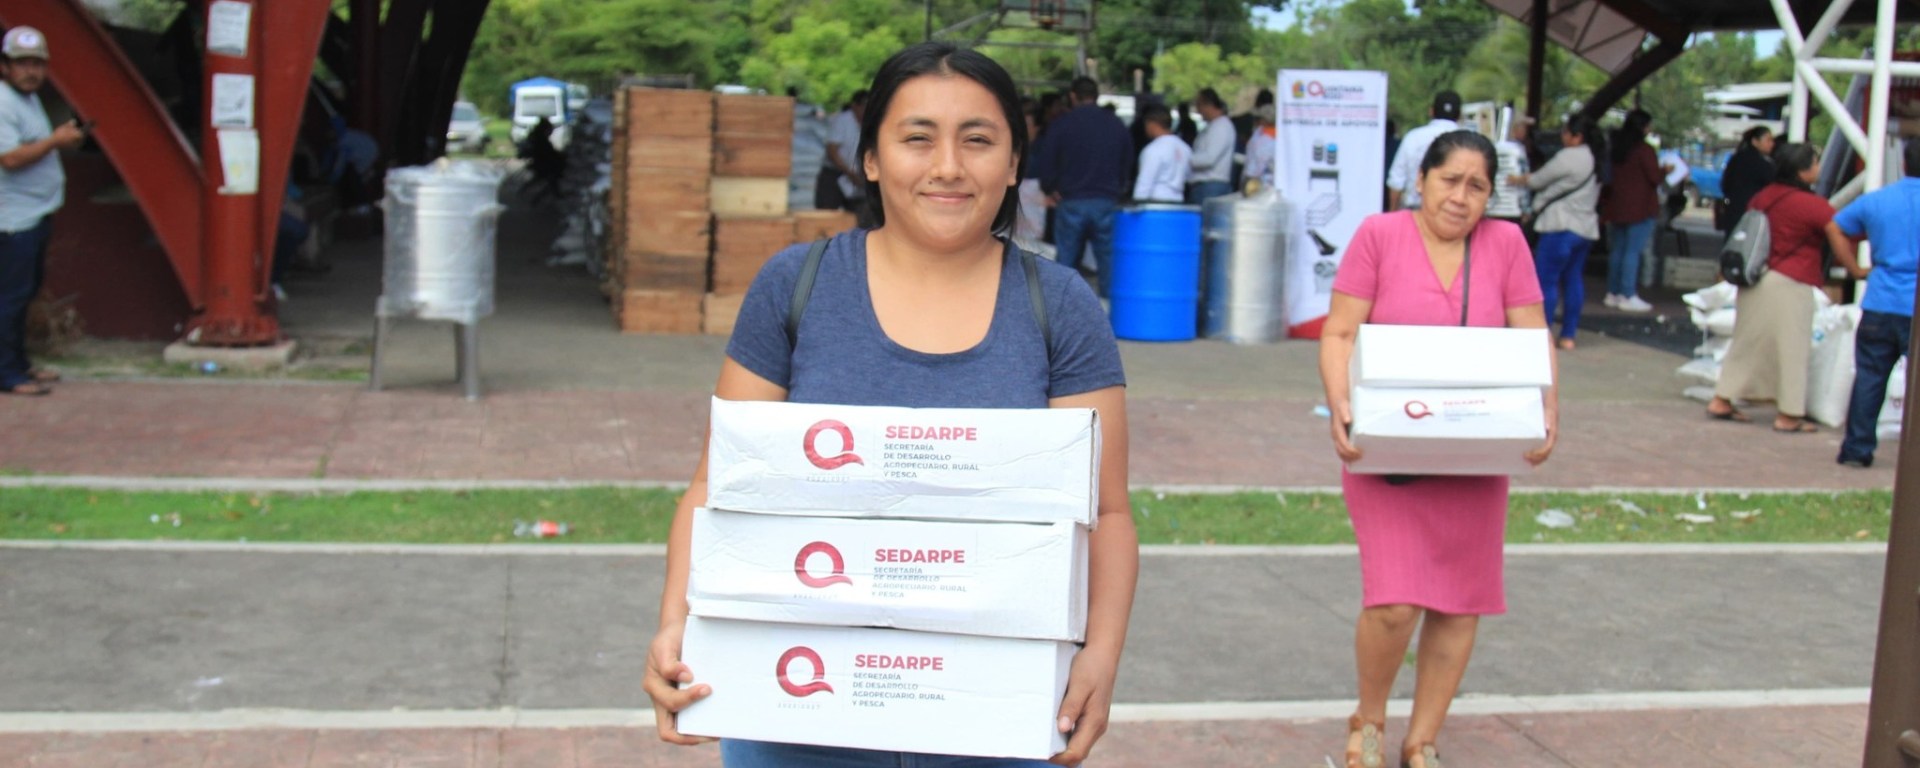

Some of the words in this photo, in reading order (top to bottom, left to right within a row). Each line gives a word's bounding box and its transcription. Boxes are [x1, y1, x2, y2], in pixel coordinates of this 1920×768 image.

[1326, 119, 1338, 127] DE
[885, 425, 977, 441] SEDARPE
[884, 443, 934, 451] SECRETARÍA
[897, 453, 951, 461] DESARROLLO
[874, 548, 965, 564] SEDARPE
[854, 654, 944, 671] SEDARPE
[853, 672, 901, 680] SECRETARÍA
[865, 682, 918, 690] DESARROLLO
[919, 693, 946, 701] RURAL
[859, 700, 885, 708] PESCA
